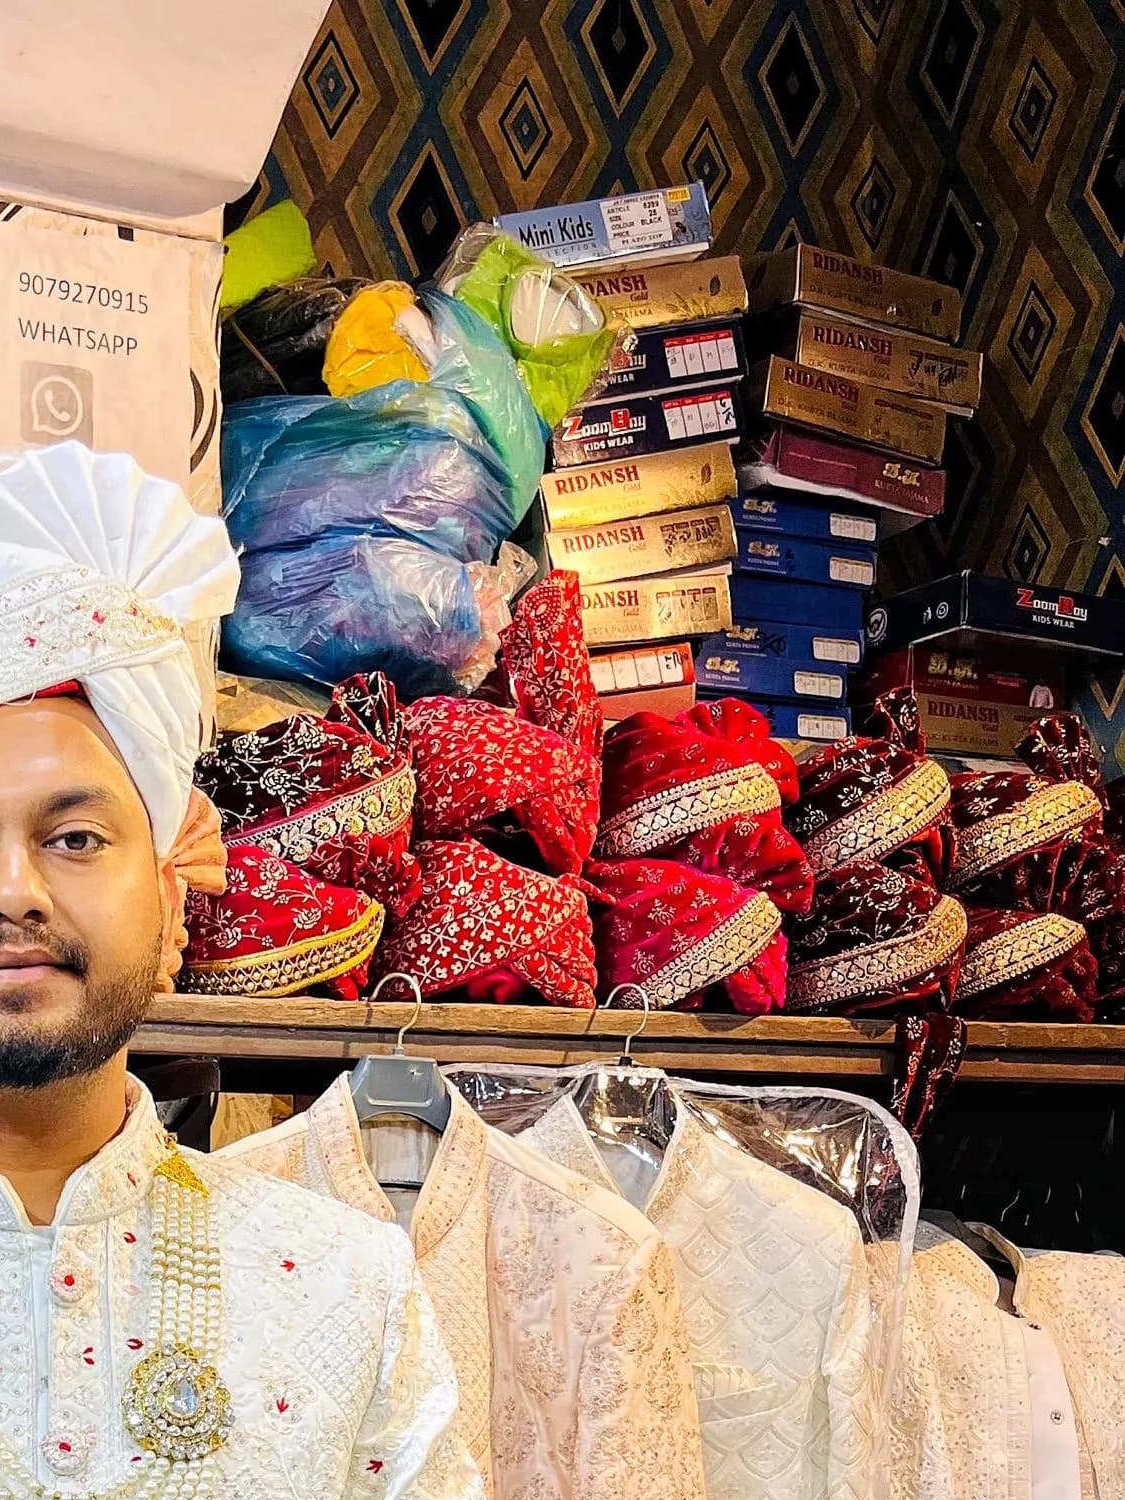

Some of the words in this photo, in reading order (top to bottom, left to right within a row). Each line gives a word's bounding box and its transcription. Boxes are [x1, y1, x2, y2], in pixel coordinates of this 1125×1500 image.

[518, 221, 555, 248] Mini
[559, 214, 595, 244] Kids
[611, 221, 635, 231] COLOUR
[641, 216, 663, 226] BLACK
[547, 241, 598, 258] LECTION
[812, 251, 884, 286] RIDANSH
[19, 272, 149, 315] 9079270915
[582, 274, 648, 298] DANSH
[630, 291, 649, 302] Gold
[18, 318, 139, 357] WHATSAPP
[812, 325, 893, 357] RIDANSH
[608, 372, 635, 385] WEAR
[783, 366, 860, 403] RIDANSH
[583, 439, 607, 452] KIDS
[608, 435, 634, 448] WEAR
[554, 464, 641, 496] RIDANSH
[562, 525, 646, 554] RIDANSH
[581, 589, 640, 611] DANSH
[1015, 588, 1088, 622] ZoomBoy
[1032, 614, 1052, 626] KIDS
[1052, 617, 1075, 629] WEAR
[928, 700, 1000, 724] RIDANSH
